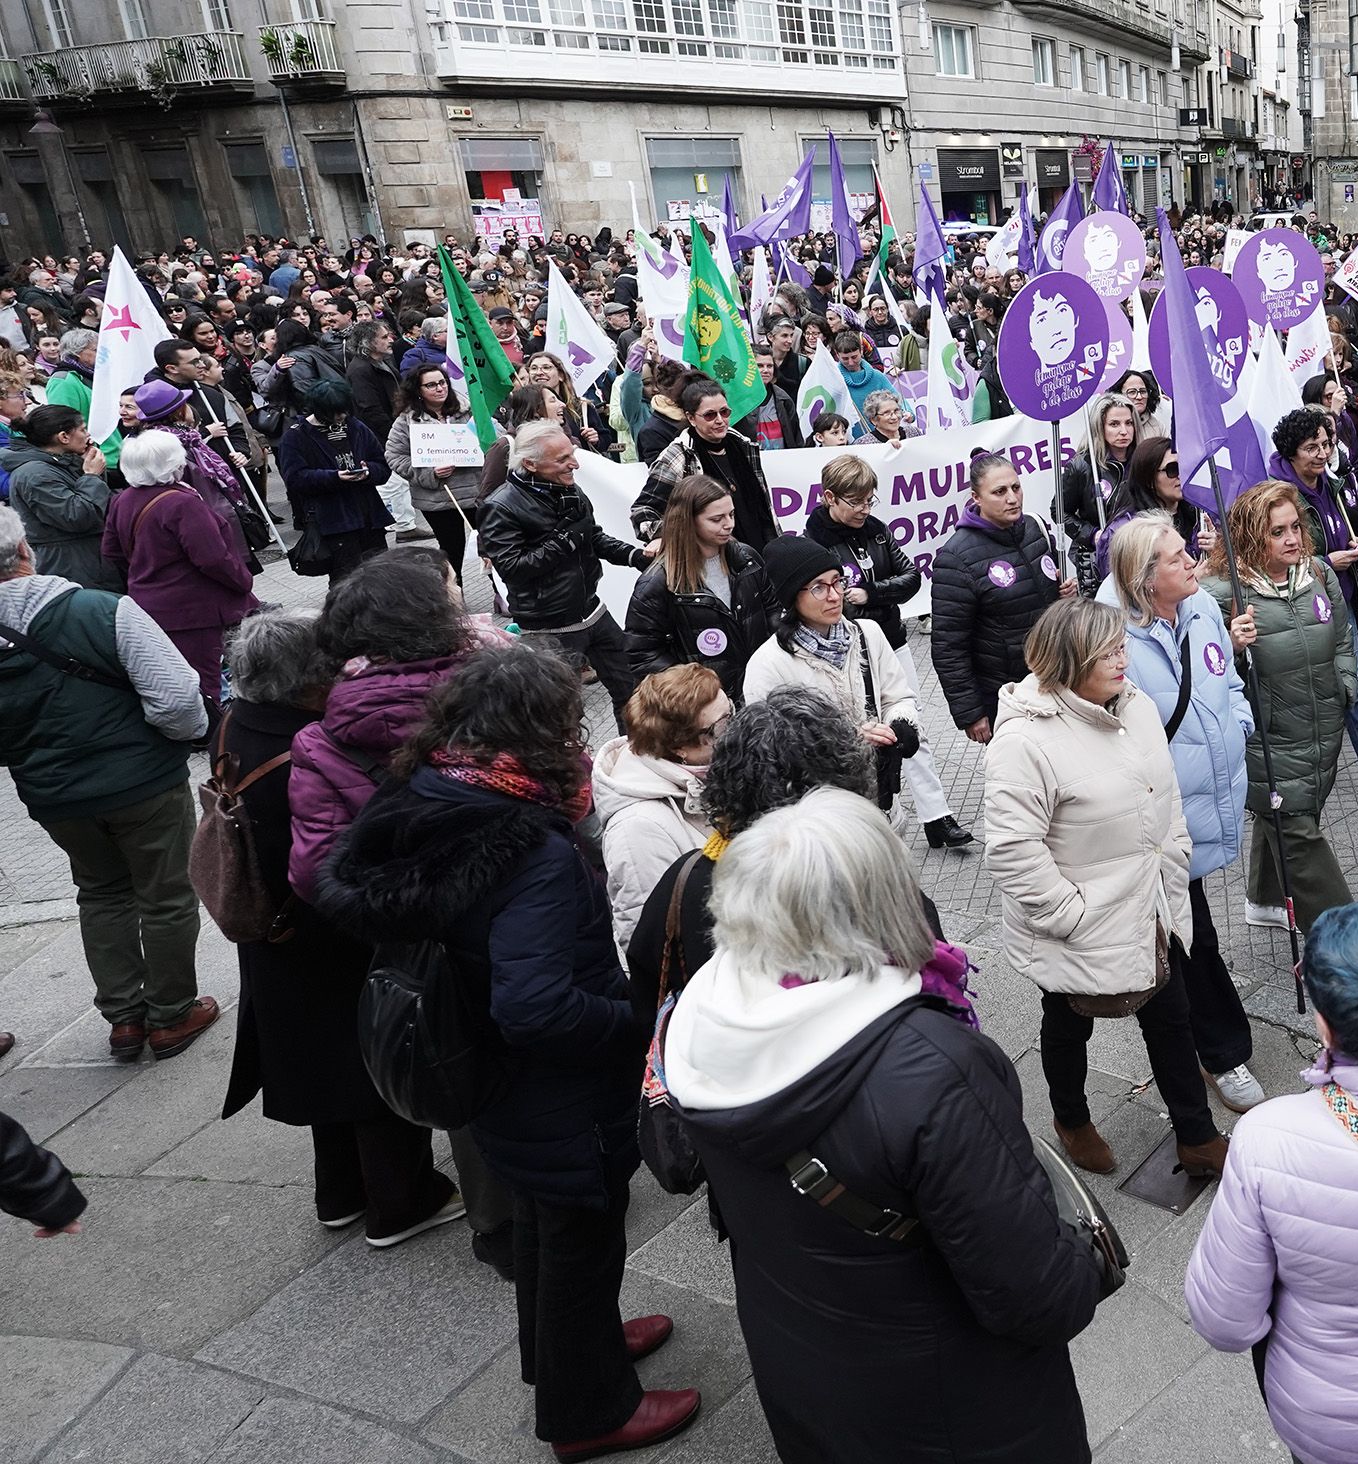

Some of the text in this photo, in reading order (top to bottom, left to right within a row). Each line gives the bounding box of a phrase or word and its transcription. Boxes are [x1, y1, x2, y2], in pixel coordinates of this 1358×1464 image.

[1035, 361, 1076, 387] feminismo
[1042, 375, 1072, 398] galego
[1061, 385, 1083, 402] clase
[421, 432, 435, 440] 8M
